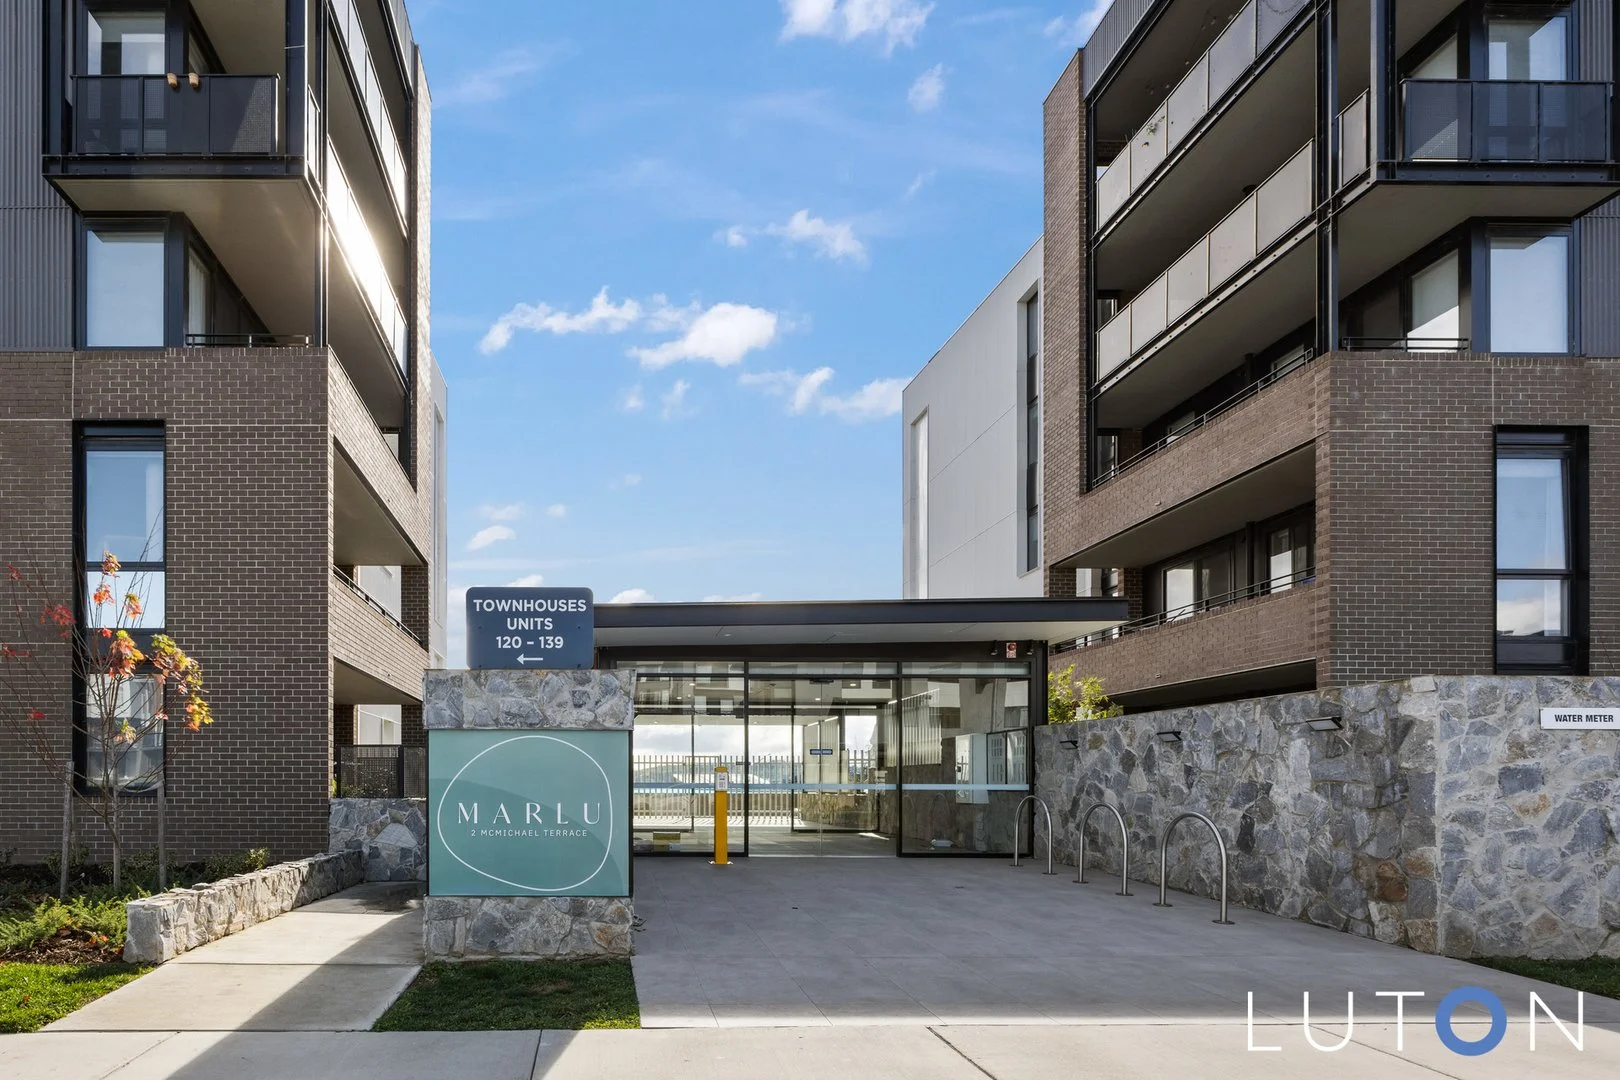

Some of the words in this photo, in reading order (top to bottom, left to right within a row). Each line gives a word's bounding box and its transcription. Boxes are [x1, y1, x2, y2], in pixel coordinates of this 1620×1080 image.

[473, 599, 587, 612] TOWNHOUSES
[506, 617, 554, 630] UNITS
[495, 636, 522, 649] 120
[538, 636, 564, 649] 139
[1554, 714, 1583, 723] WATER
[1585, 714, 1614, 723] METER
[458, 802, 600, 825] MARLU
[470, 829, 476, 837] 2
[480, 829, 539, 837] MCMICHAEL
[543, 829, 588, 837] TERRACE
